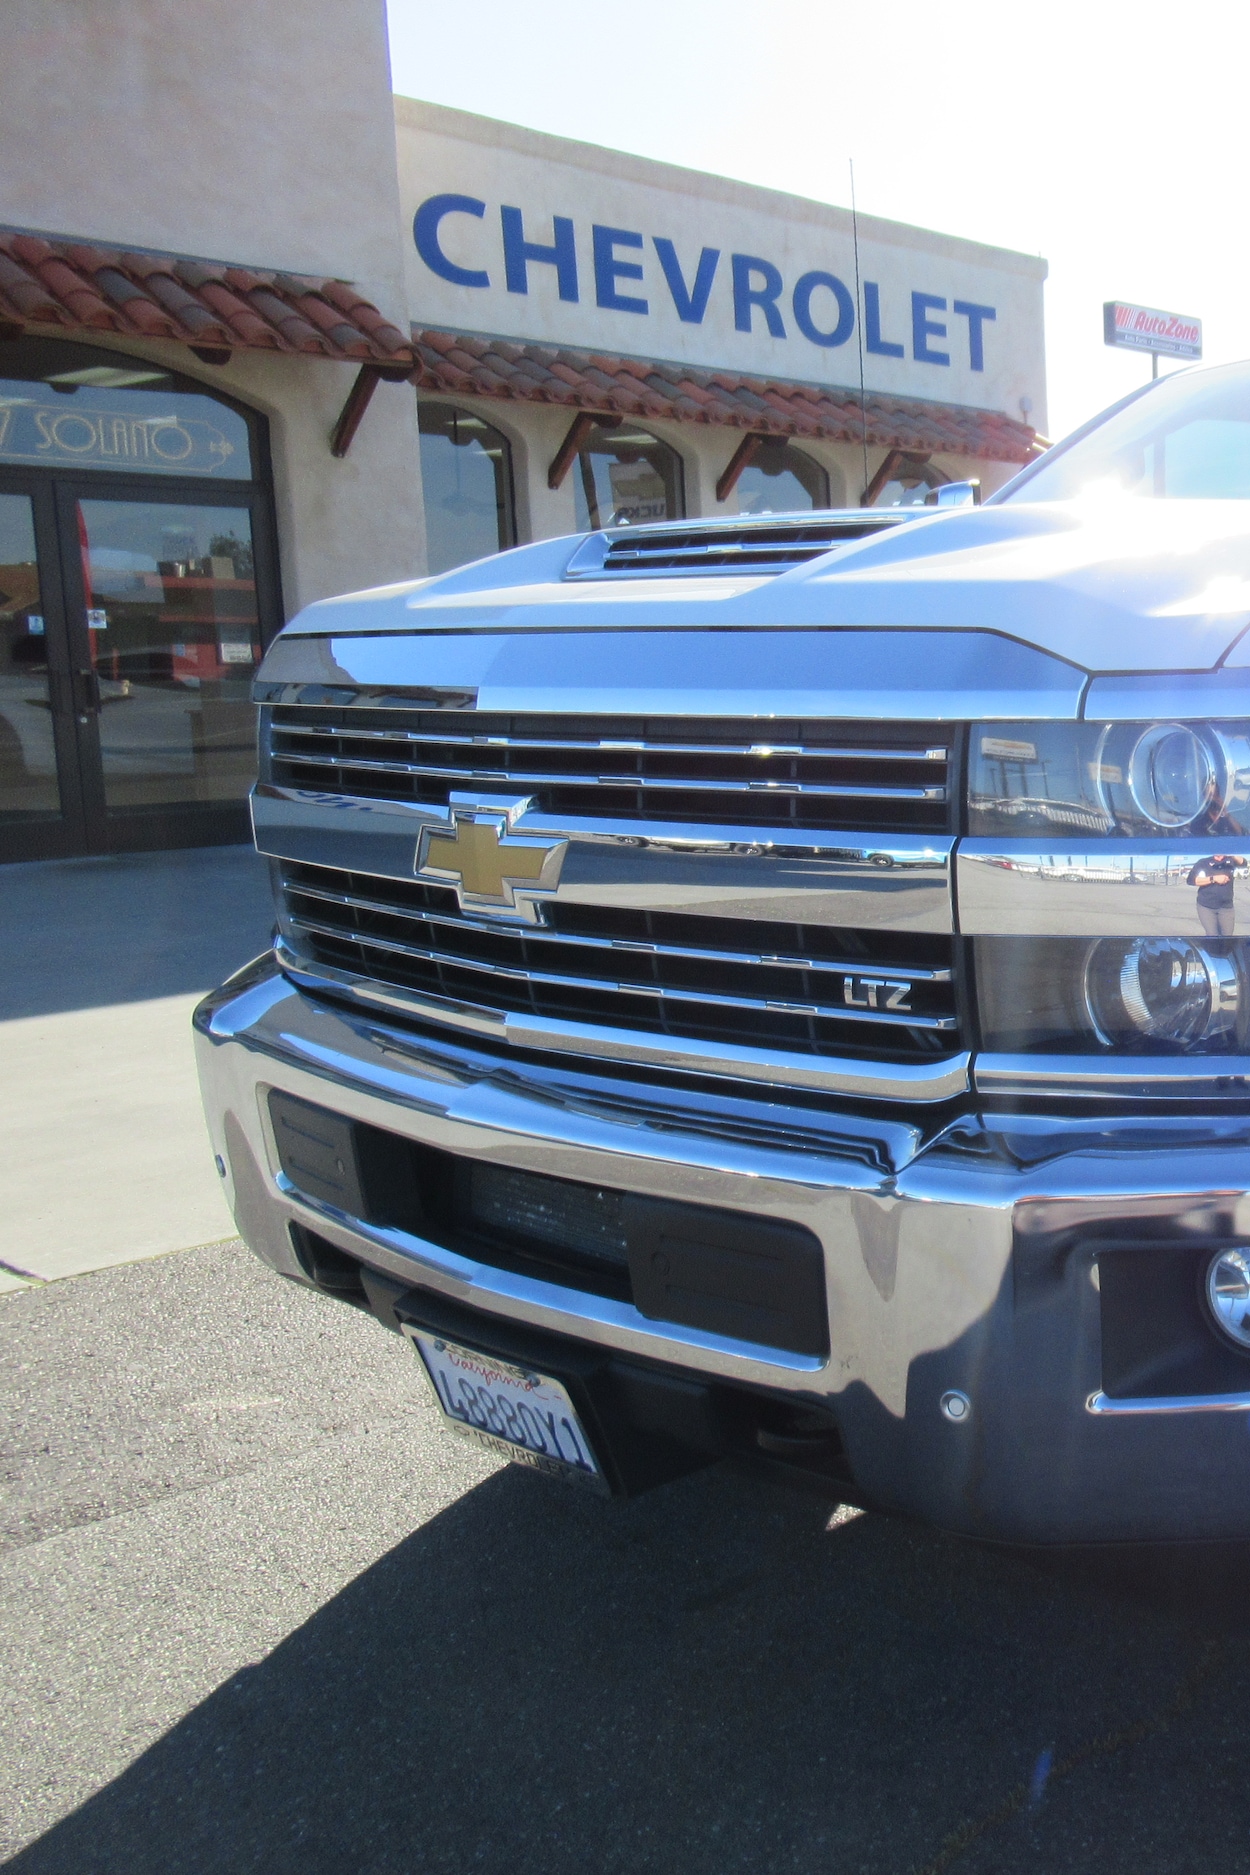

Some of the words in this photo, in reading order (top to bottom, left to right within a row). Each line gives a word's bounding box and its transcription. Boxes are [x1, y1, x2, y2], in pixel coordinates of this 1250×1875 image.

[413, 193, 996, 372] CHEVROLET
[1134, 311, 1199, 343] AutoZone
[35, 411, 192, 460] SOLANO
[844, 976, 912, 1011] LTZ
[449, 1353, 549, 1400] California
[437, 1369, 593, 1474] 48880Y1
